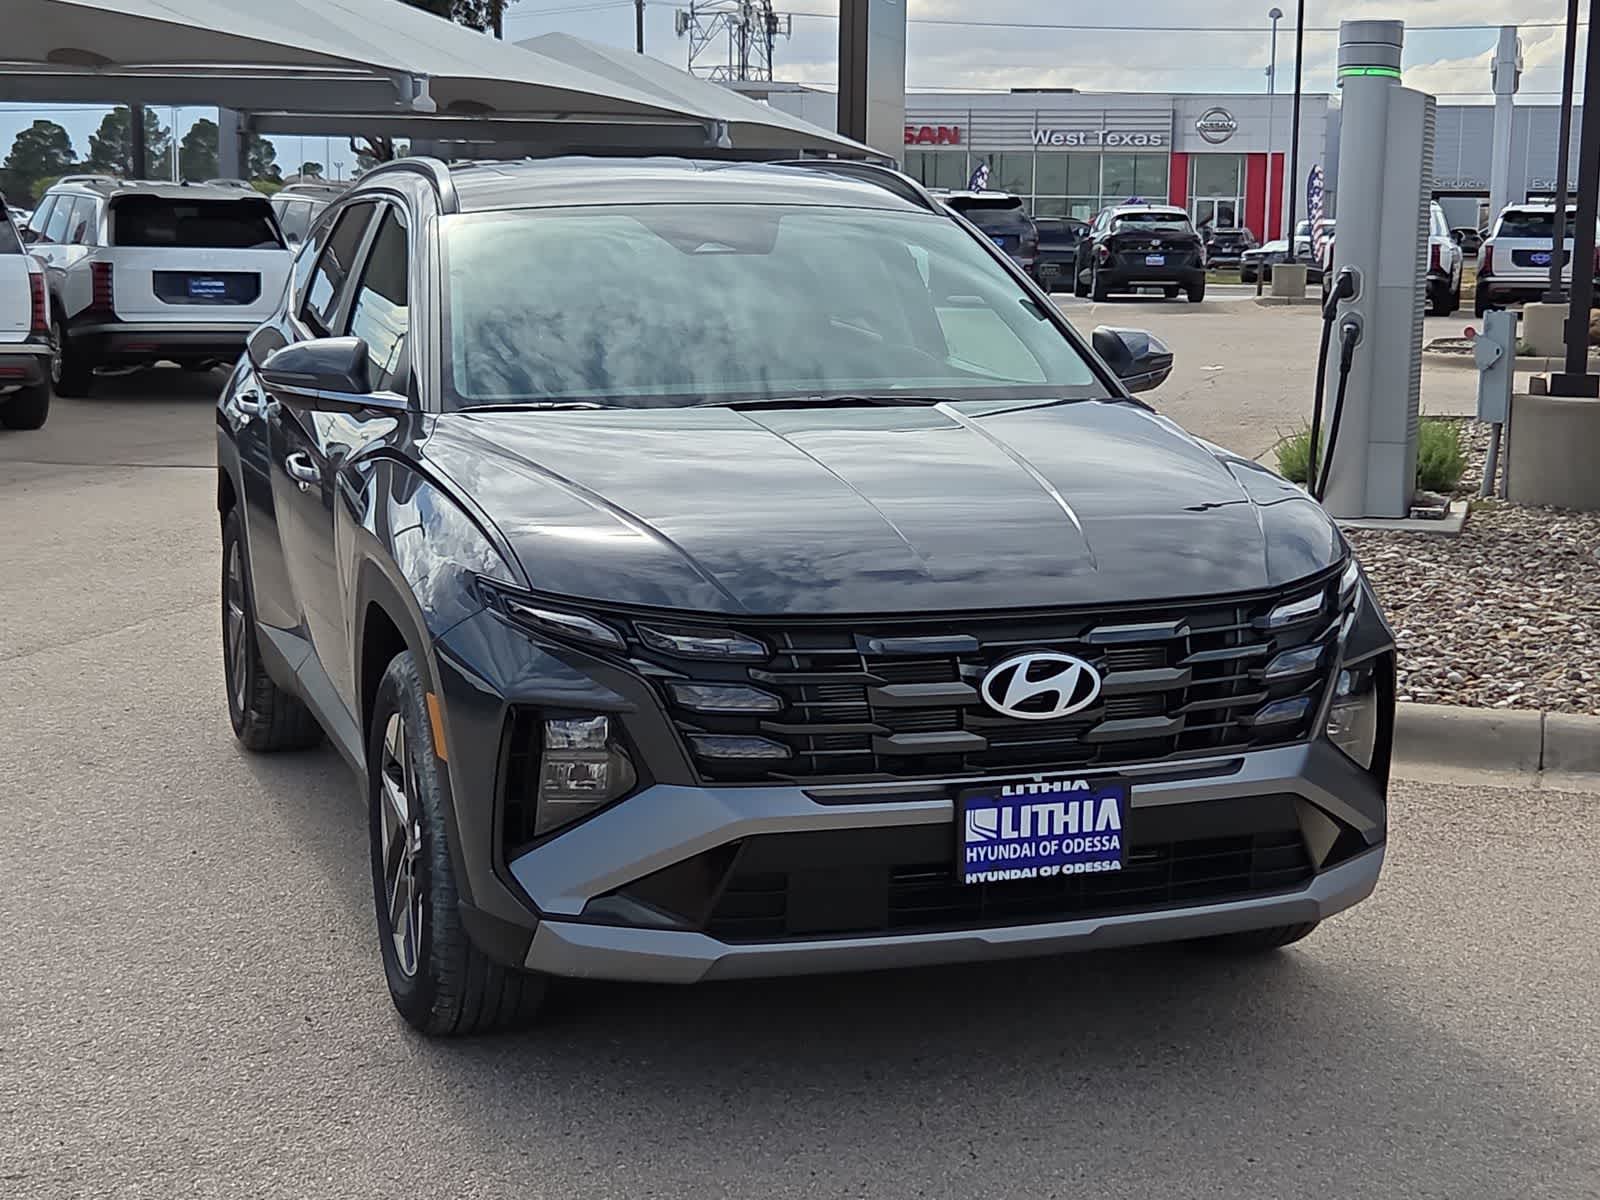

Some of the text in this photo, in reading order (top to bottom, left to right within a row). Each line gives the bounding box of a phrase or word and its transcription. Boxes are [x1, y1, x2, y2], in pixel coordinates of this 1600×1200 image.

[1031, 130, 1162, 146] West Texas
[1002, 779, 1090, 796] LITHIA
[1001, 798, 1121, 839] LITHIA
[966, 835, 1121, 863] HYUNDAI OF ODESSA
[965, 860, 1122, 884] HYUNDAI OF ODESSA
